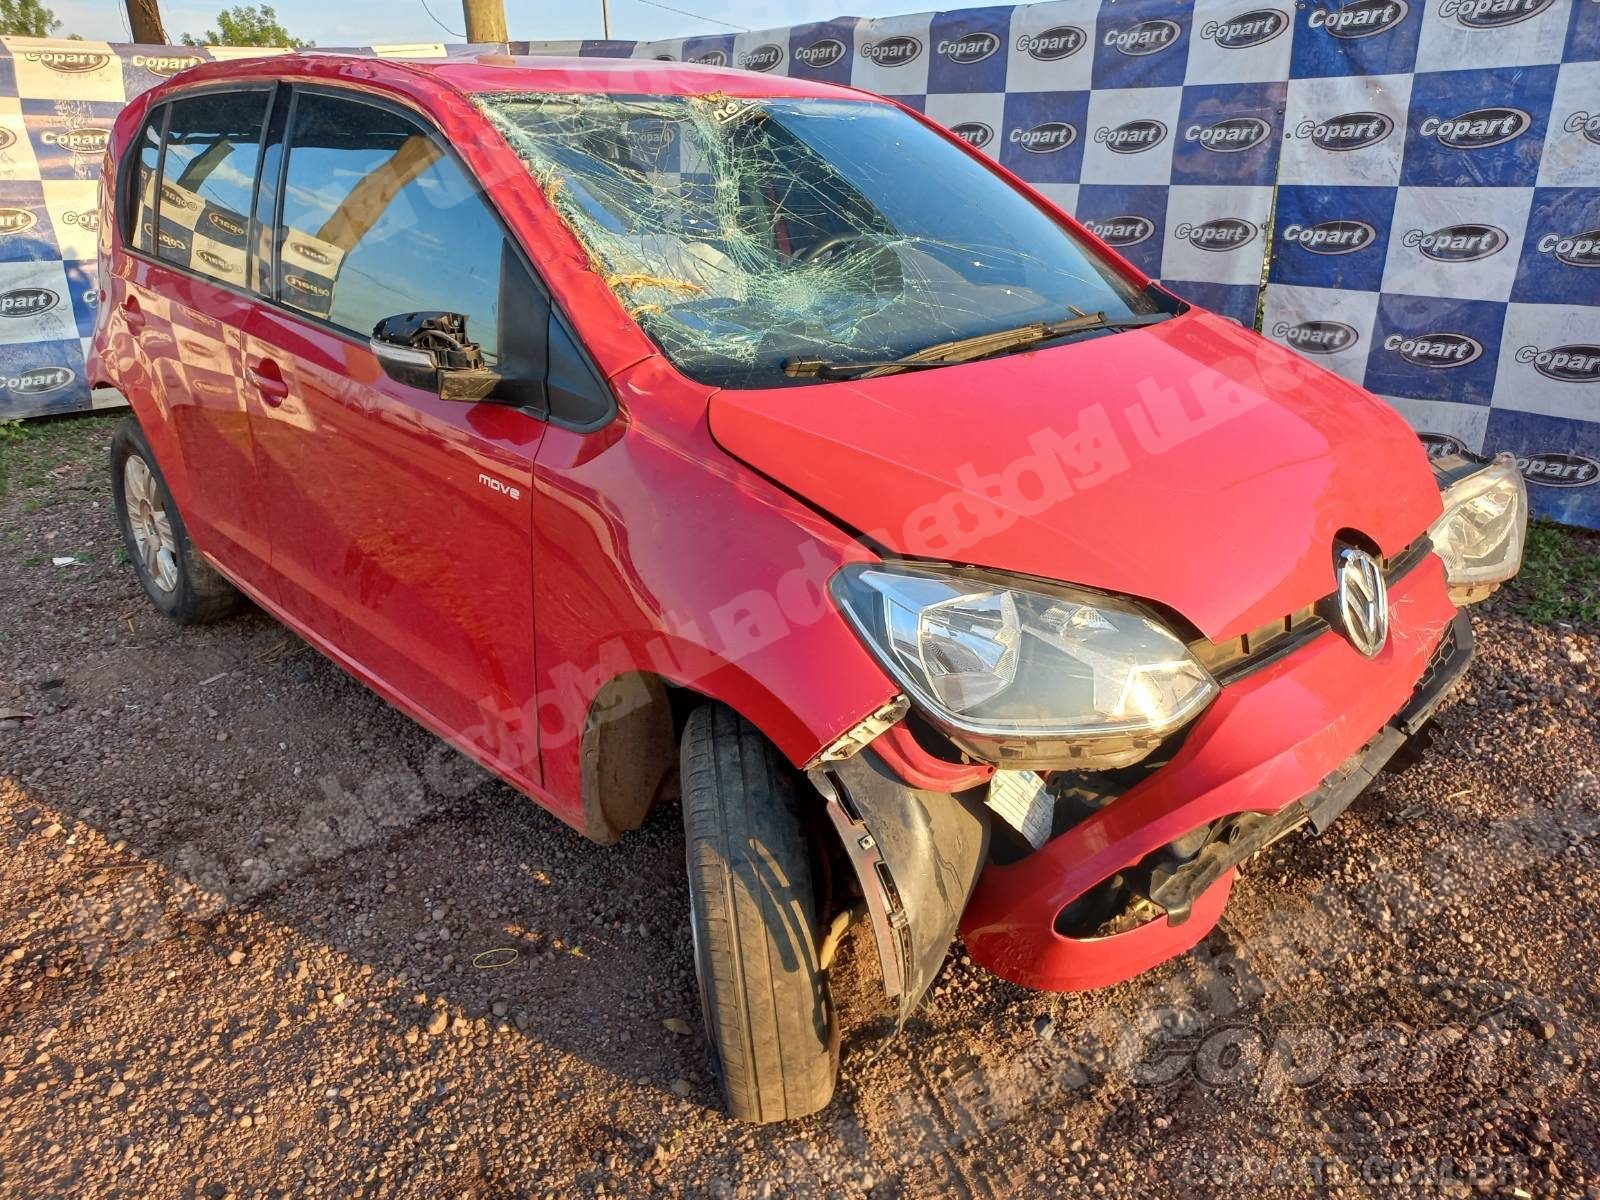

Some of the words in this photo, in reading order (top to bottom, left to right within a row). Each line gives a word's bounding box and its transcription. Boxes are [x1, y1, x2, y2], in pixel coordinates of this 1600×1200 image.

[1308, 3, 1393, 28] Copart
[1439, 0, 1534, 18] Copart
[1104, 26, 1169, 48] Copart
[1201, 17, 1273, 40] Copart
[795, 45, 840, 61] Copart
[861, 41, 915, 60] Copart
[937, 37, 990, 56] Copart
[1016, 32, 1075, 55] Copart
[25, 52, 97, 65] Copart
[132, 55, 198, 72] Copart
[738, 50, 775, 66] Copart
[1010, 128, 1067, 147] Copart
[1095, 124, 1155, 146] Copart
[1185, 121, 1264, 143] Copart
[1296, 119, 1383, 140] Copart
[1419, 115, 1516, 140] Copart
[1081, 220, 1143, 239] Copart
[1175, 223, 1244, 242] Copart
[1283, 225, 1364, 246] Copart
[1403, 229, 1492, 252] Copart
[0, 293, 47, 312] part
[1272, 321, 1344, 346] Copart
[1384, 334, 1470, 360] Copart
[1515, 346, 1600, 371] Copar
[1517, 458, 1590, 480] opart
[479, 473, 520, 500] move
